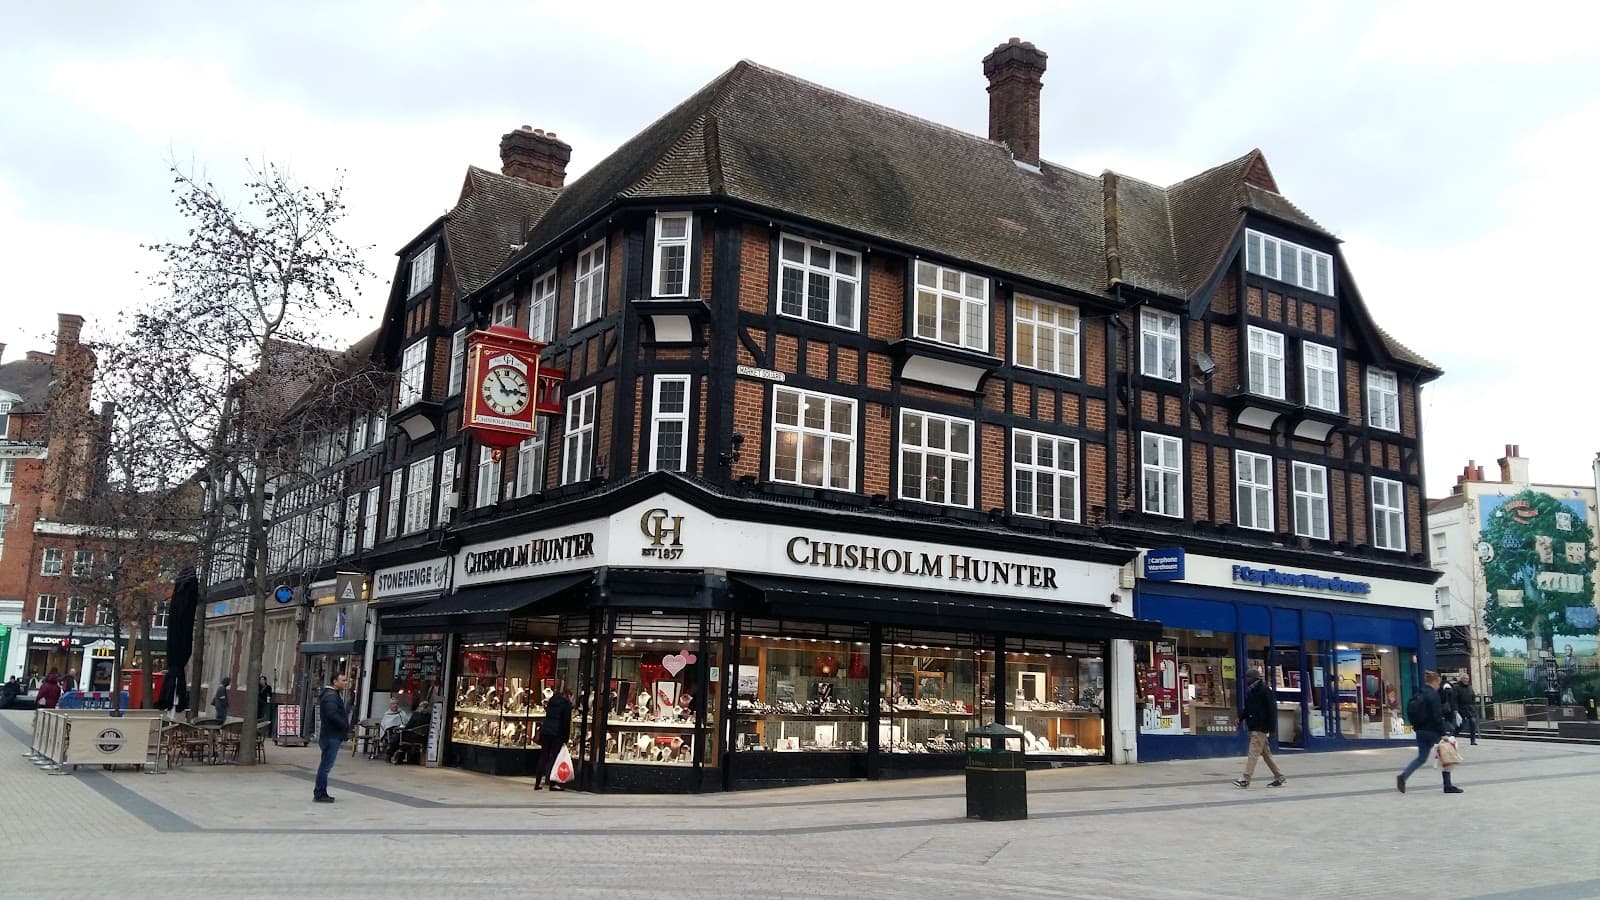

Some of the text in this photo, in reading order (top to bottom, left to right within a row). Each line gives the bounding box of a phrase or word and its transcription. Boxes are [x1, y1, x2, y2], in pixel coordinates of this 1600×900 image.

[739, 365, 785, 381] MARKET SQUARE
[464, 532, 594, 575] CHISHOLM HUNTER
[641, 548, 684, 559] EST 1857
[786, 536, 1058, 589] CHISHOLM HUNTER
[377, 567, 432, 592] STONEHENGE
[1240, 566, 1371, 594] Carphone Warehouse
[1143, 705, 1162, 730] BIG
